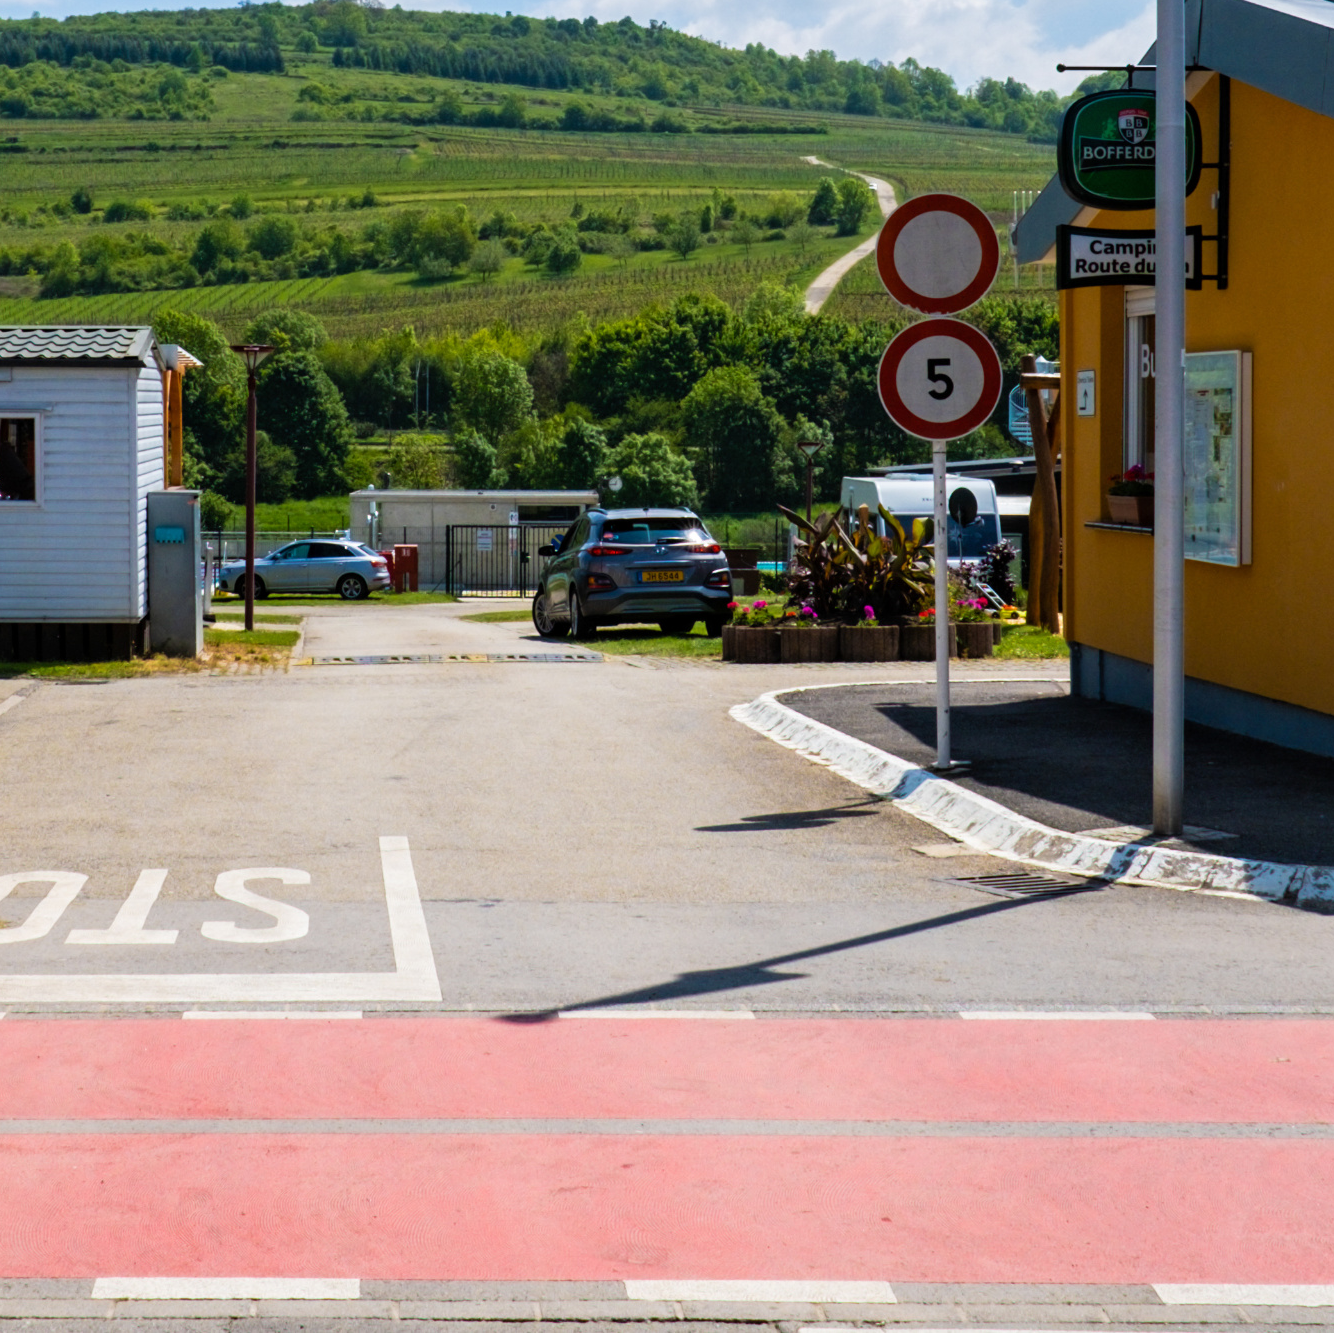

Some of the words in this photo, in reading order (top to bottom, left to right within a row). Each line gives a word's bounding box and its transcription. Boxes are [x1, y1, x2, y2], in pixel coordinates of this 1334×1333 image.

[1126, 118, 1133, 128] B
[1135, 118, 1143, 128] B
[1083, 146, 1156, 160] BOFFERD
[1089, 240, 1155, 258] Campi
[1075, 259, 1130, 273] Route
[927, 358, 954, 400] 5
